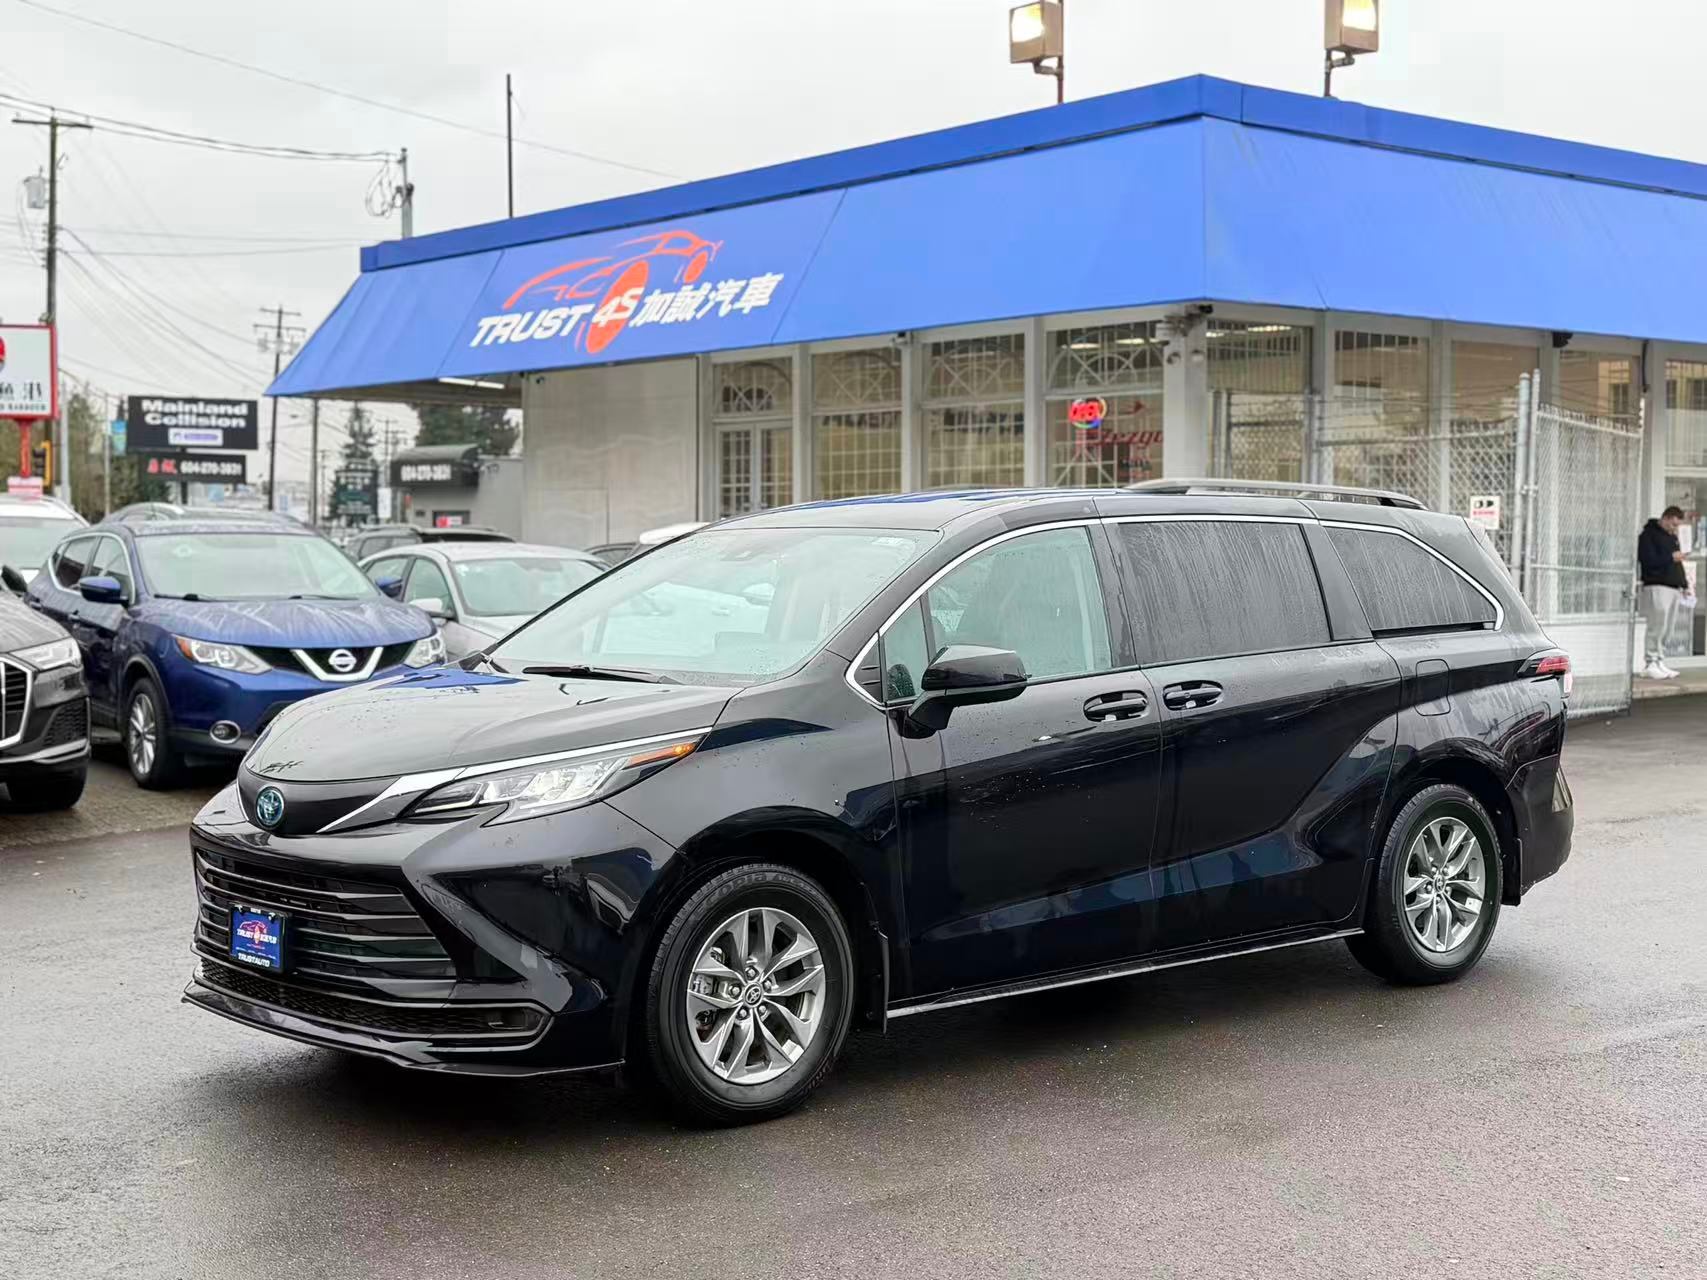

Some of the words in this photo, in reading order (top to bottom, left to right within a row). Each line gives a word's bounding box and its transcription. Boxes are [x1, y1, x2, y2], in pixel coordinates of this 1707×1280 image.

[469, 303, 594, 347] TRUST
[591, 287, 645, 327] 4S
[629, 272, 785, 327] 加誠汽車
[142, 399, 248, 416] Mainland
[144, 412, 246, 428] Collision
